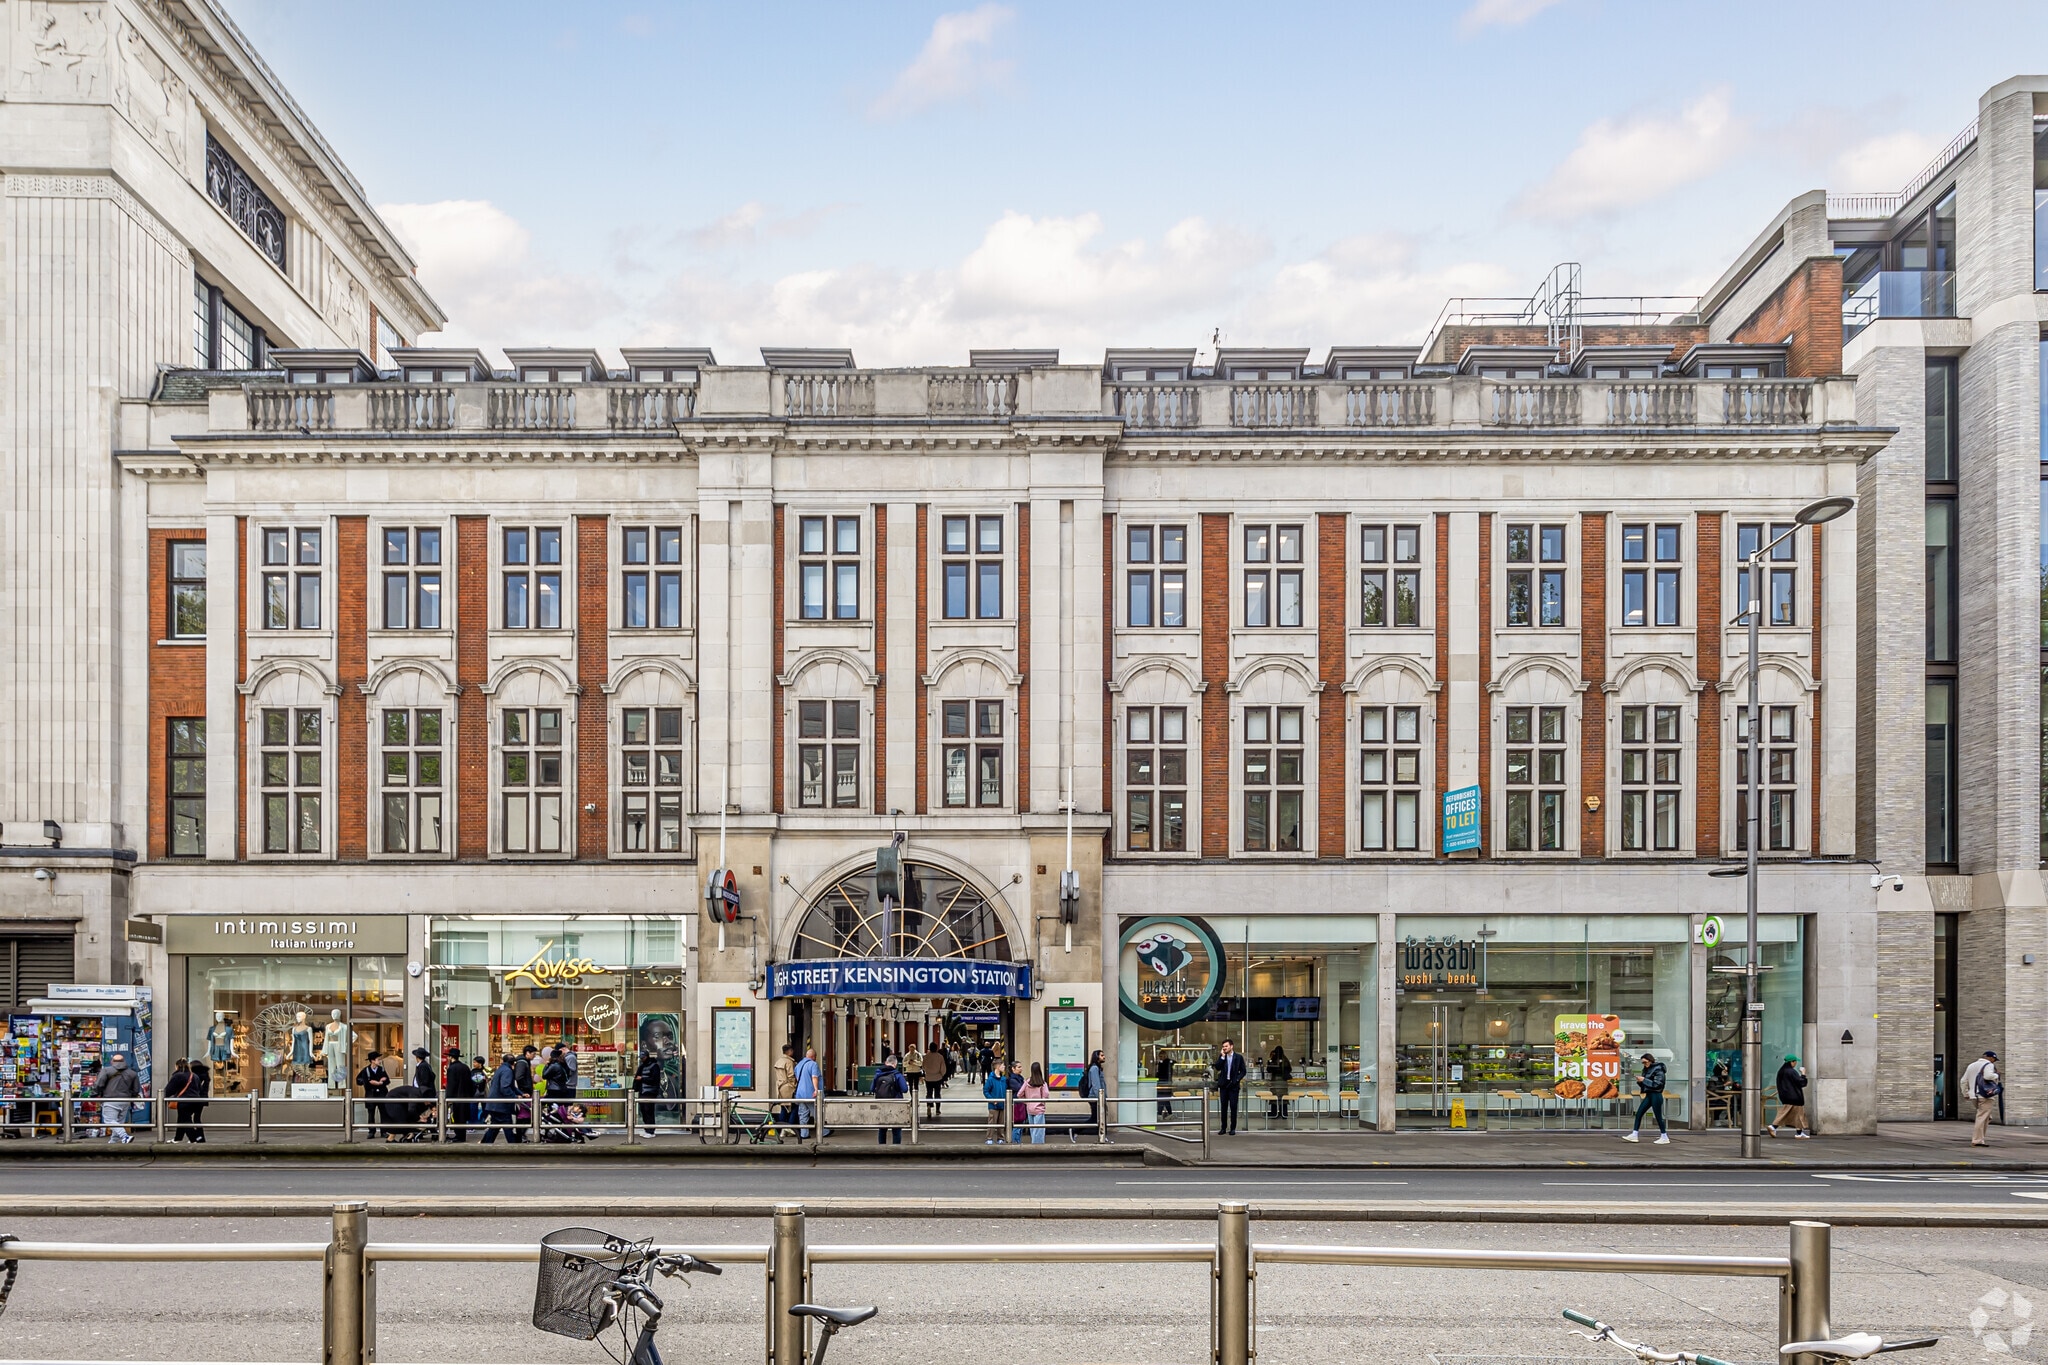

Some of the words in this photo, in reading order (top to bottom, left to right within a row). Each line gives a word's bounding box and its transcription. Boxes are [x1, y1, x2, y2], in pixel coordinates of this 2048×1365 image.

[1446, 790, 1475, 803] REFURBISHED
[1446, 798, 1476, 815] OFFICES
[1446, 816, 1456, 830] TO
[1459, 812, 1475, 827] LET
[215, 919, 357, 934] intimissimi
[270, 939, 307, 948] Italian
[310, 939, 355, 951] lingerie
[1405, 934, 1456, 947] わさび
[1405, 940, 1476, 970] wasabi
[504, 939, 605, 989] Lovisa
[791, 968, 838, 985] STREET
[845, 967, 966, 984] KENSINGTON
[971, 969, 1016, 987] STATION
[1405, 972, 1432, 985] sushi
[1447, 972, 1476, 985] bento
[587, 1008, 619, 1023] Piercing
[592, 1004, 609, 1014] Free
[1560, 1021, 1586, 1029] krave
[1588, 1021, 1605, 1029] the
[443, 1036, 457, 1047] SALE
[1555, 1056, 1618, 1077] katsu
[583, 1090, 609, 1098] HOTTEST
